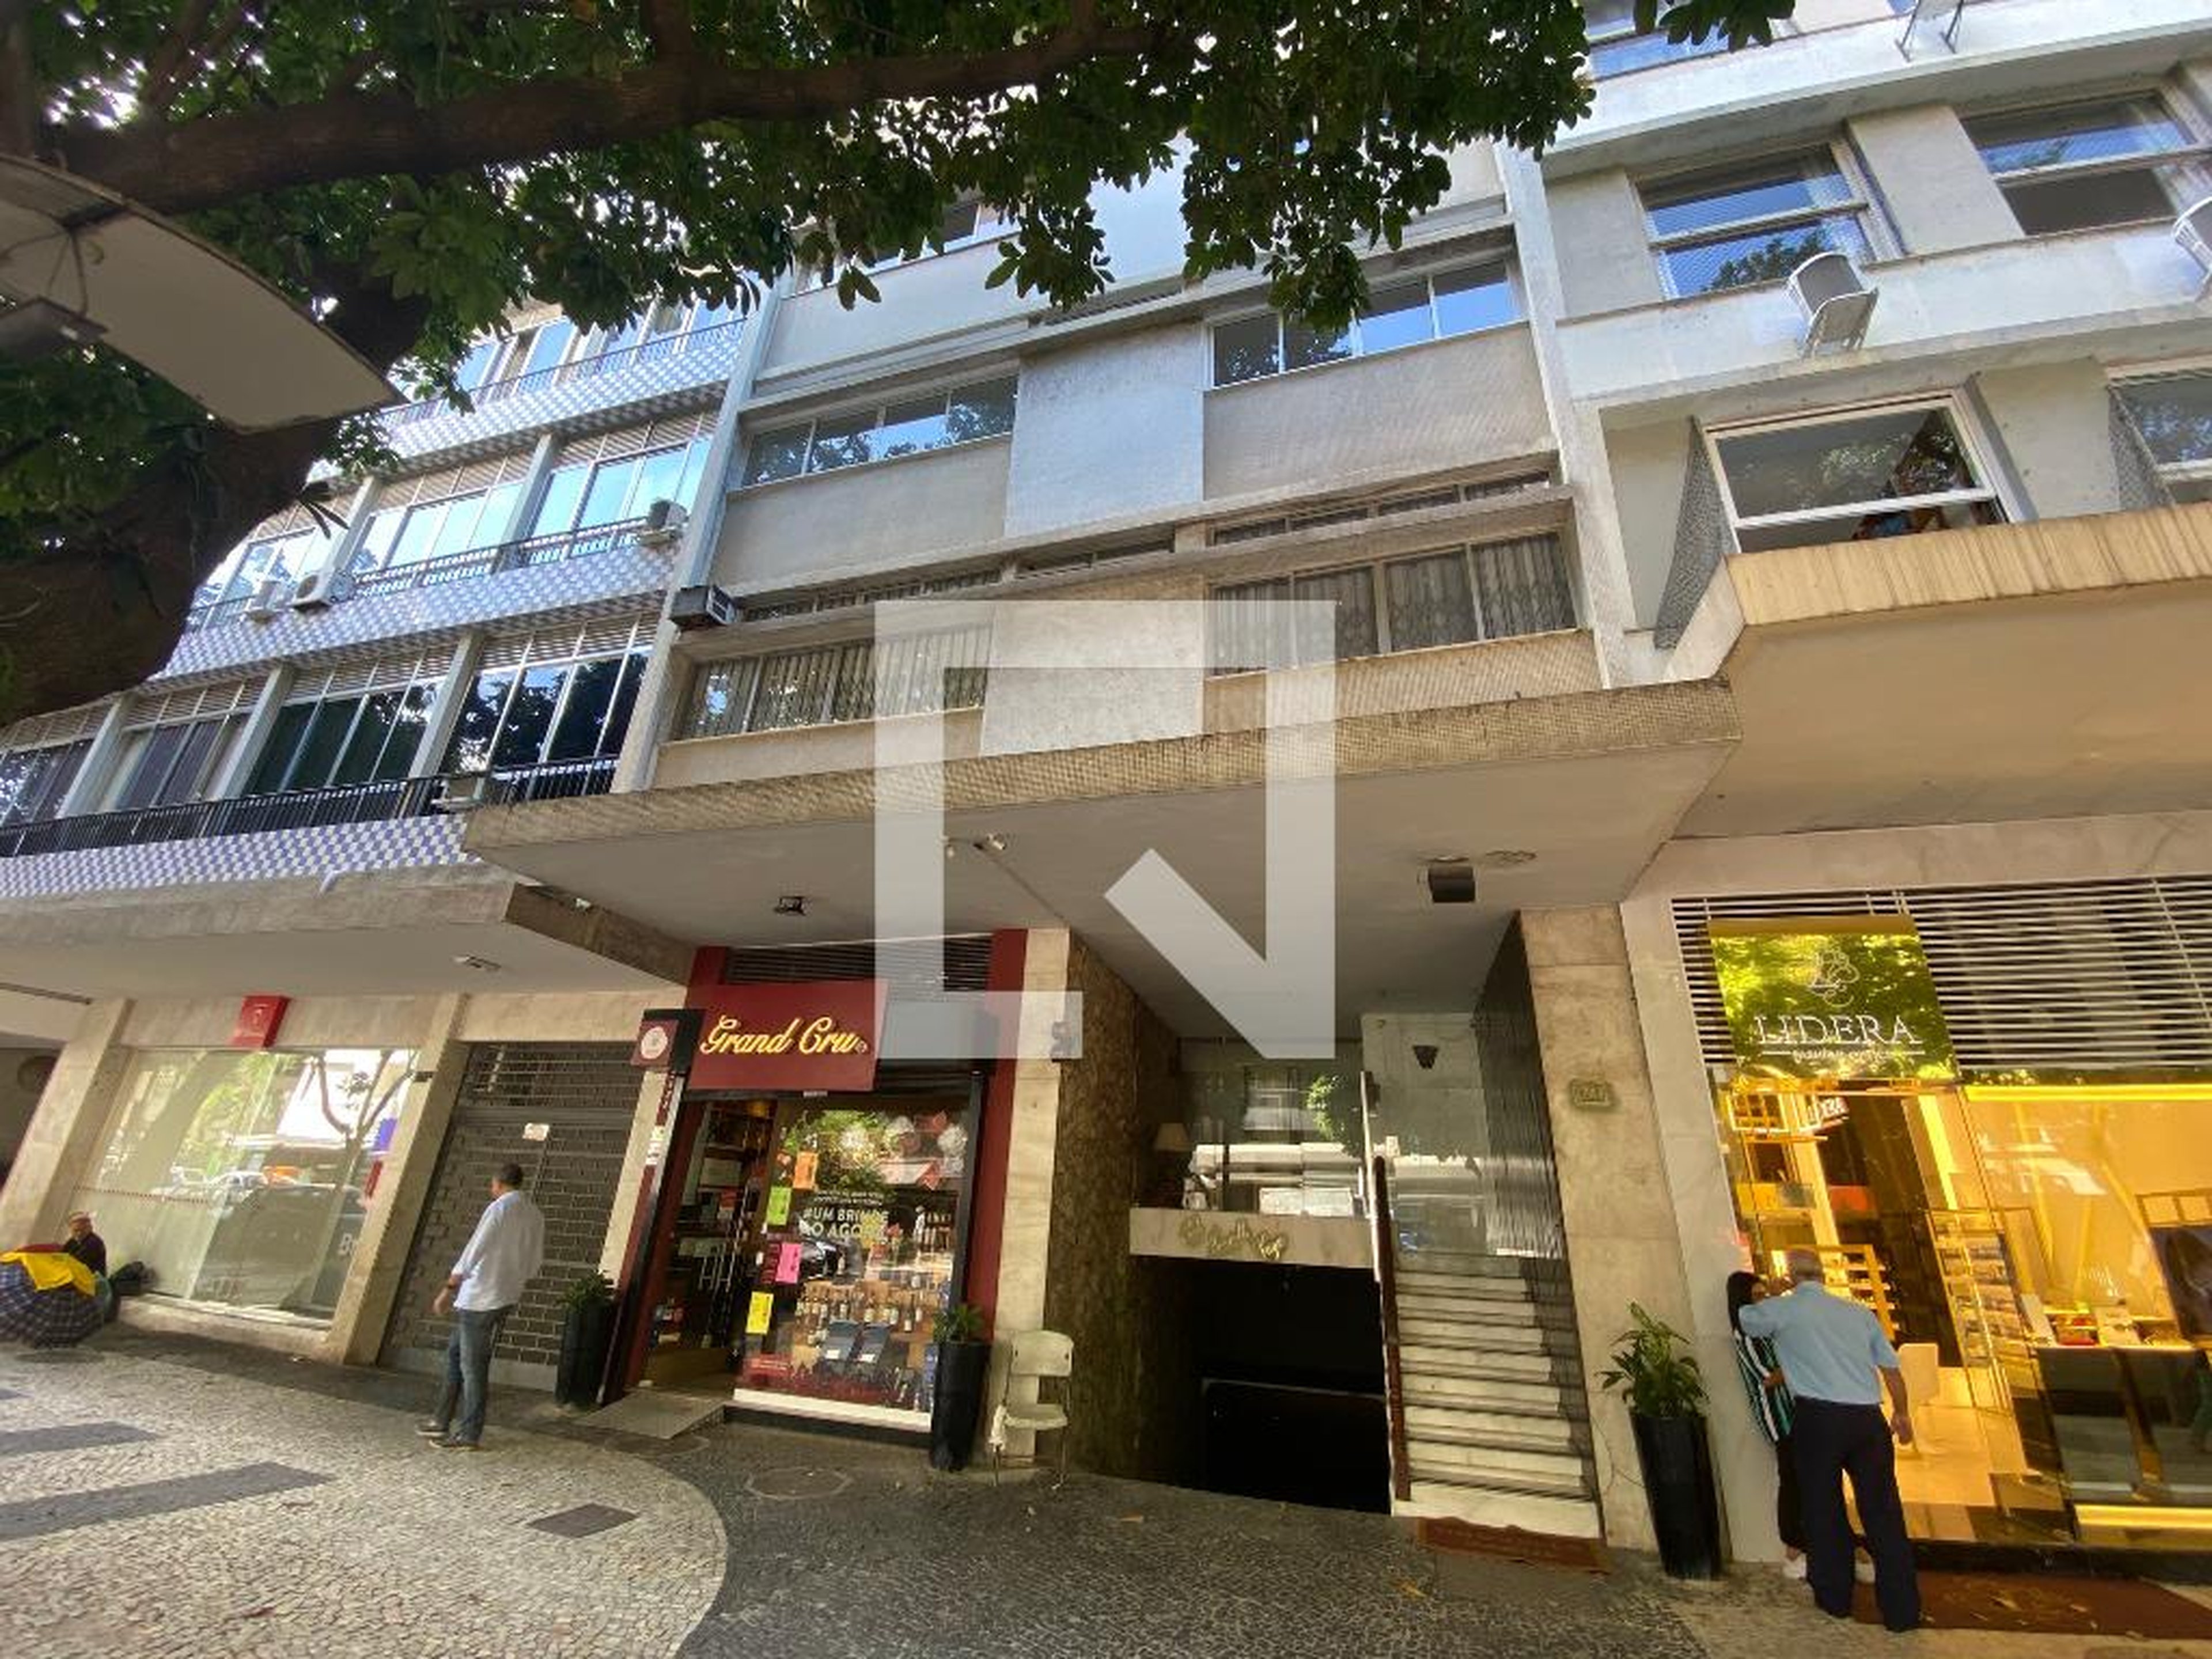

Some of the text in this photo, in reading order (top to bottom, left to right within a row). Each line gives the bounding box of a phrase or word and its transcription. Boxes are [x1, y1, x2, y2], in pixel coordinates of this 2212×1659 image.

[700, 1015, 801, 1054] Grand
[1754, 1015, 1923, 1044] LIDERA
[837, 1209, 889, 1224] BRIE
